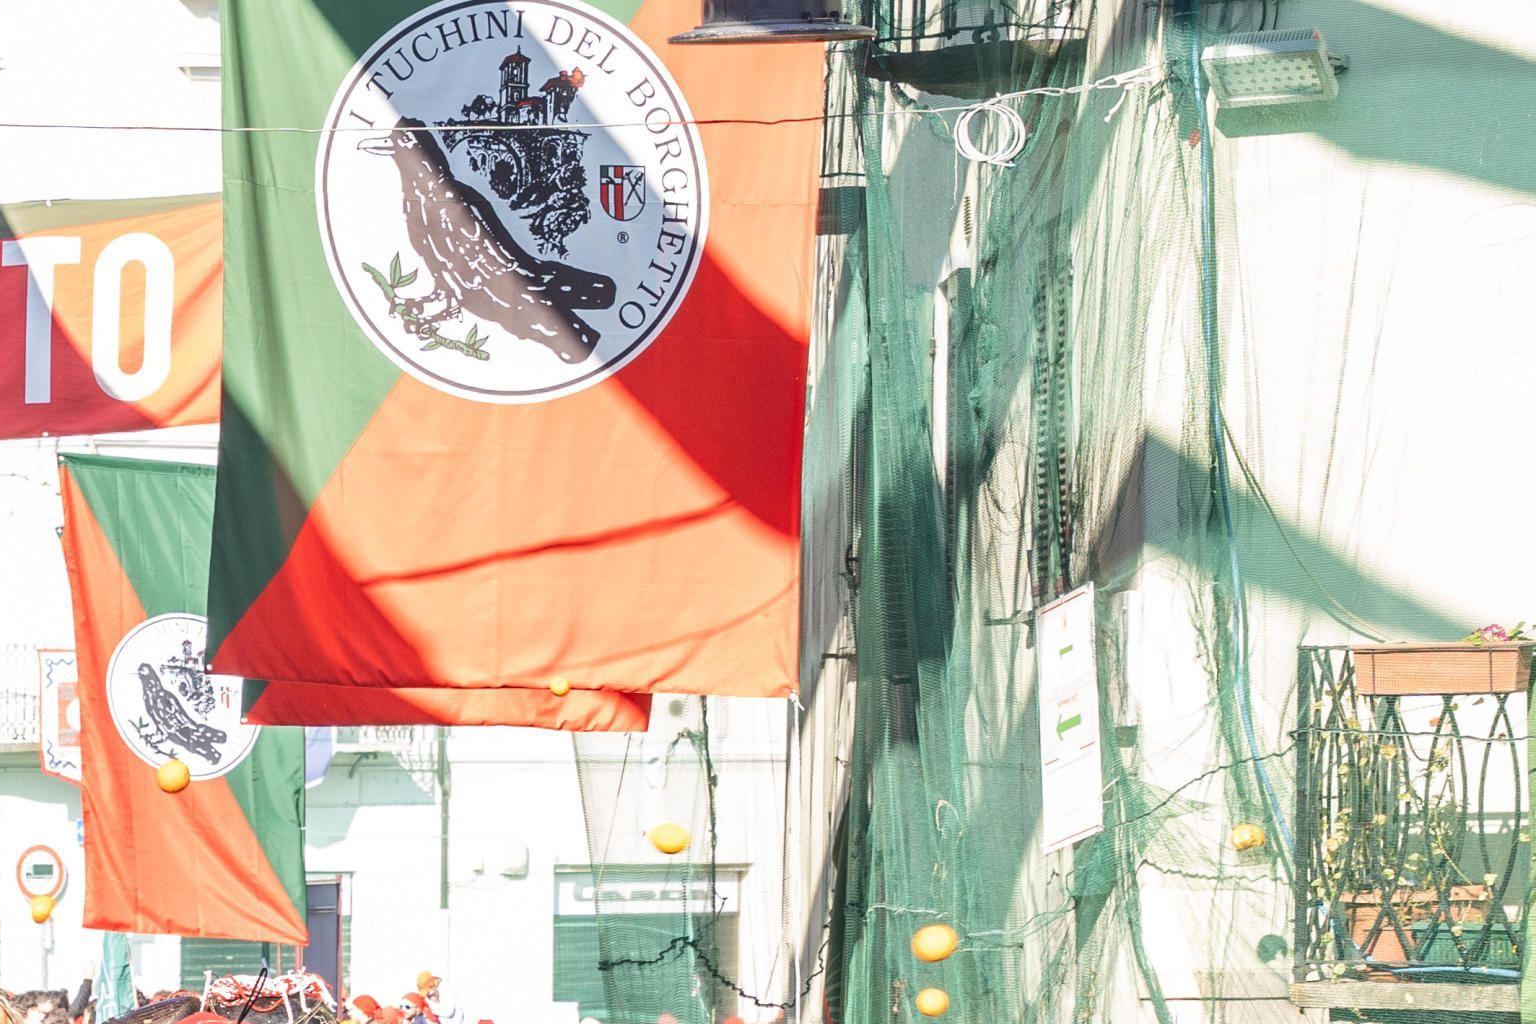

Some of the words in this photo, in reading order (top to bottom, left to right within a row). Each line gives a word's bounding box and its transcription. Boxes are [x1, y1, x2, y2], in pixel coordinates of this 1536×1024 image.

[349, 108, 377, 131] I
[364, 8, 526, 101] TUCHINI
[544, 16, 616, 77] DEL
[618, 82, 690, 332] BORGHETTO
